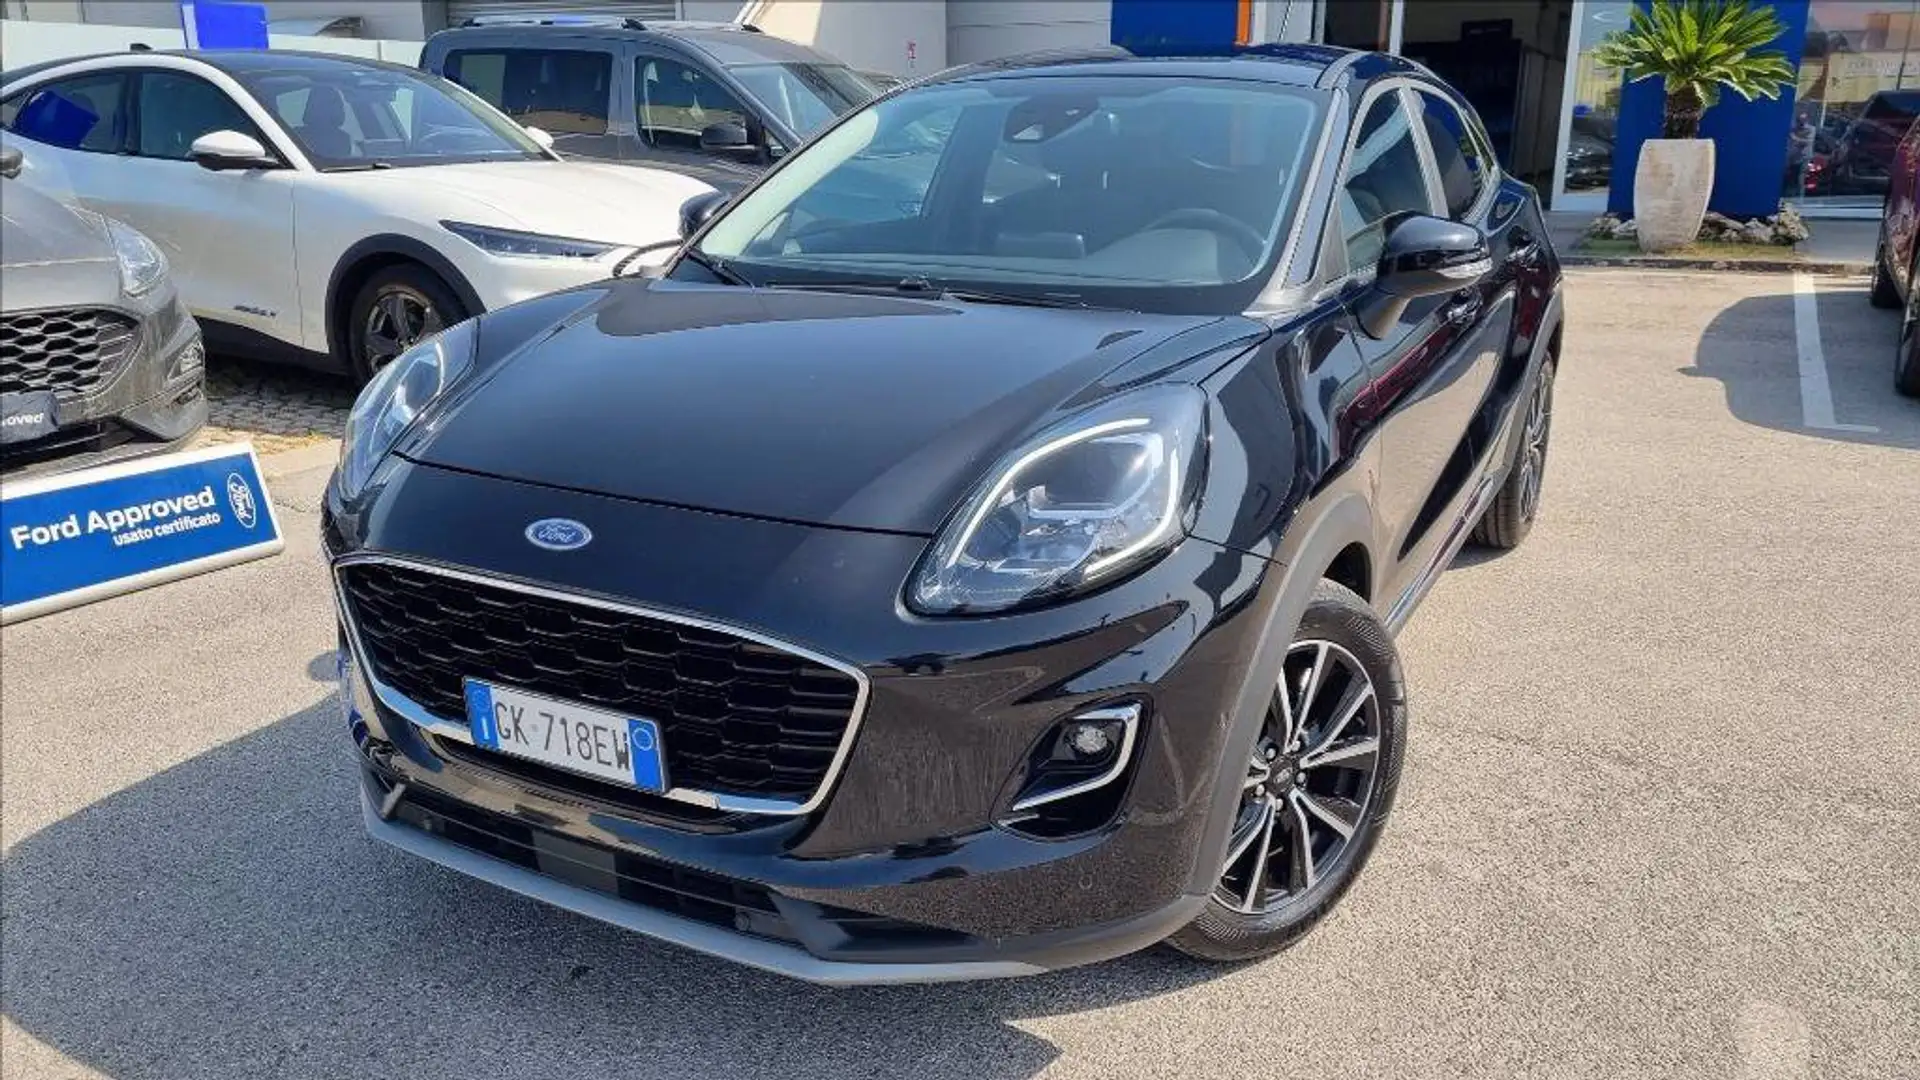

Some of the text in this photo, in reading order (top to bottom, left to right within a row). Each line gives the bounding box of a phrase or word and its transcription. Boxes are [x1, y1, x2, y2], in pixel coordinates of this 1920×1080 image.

[10, 485, 216, 550] Ford Approved
[230, 481, 254, 519] Ford
[113, 512, 221, 547] usato certificato
[537, 524, 579, 543] Ford
[495, 701, 630, 771] GK 718EW
